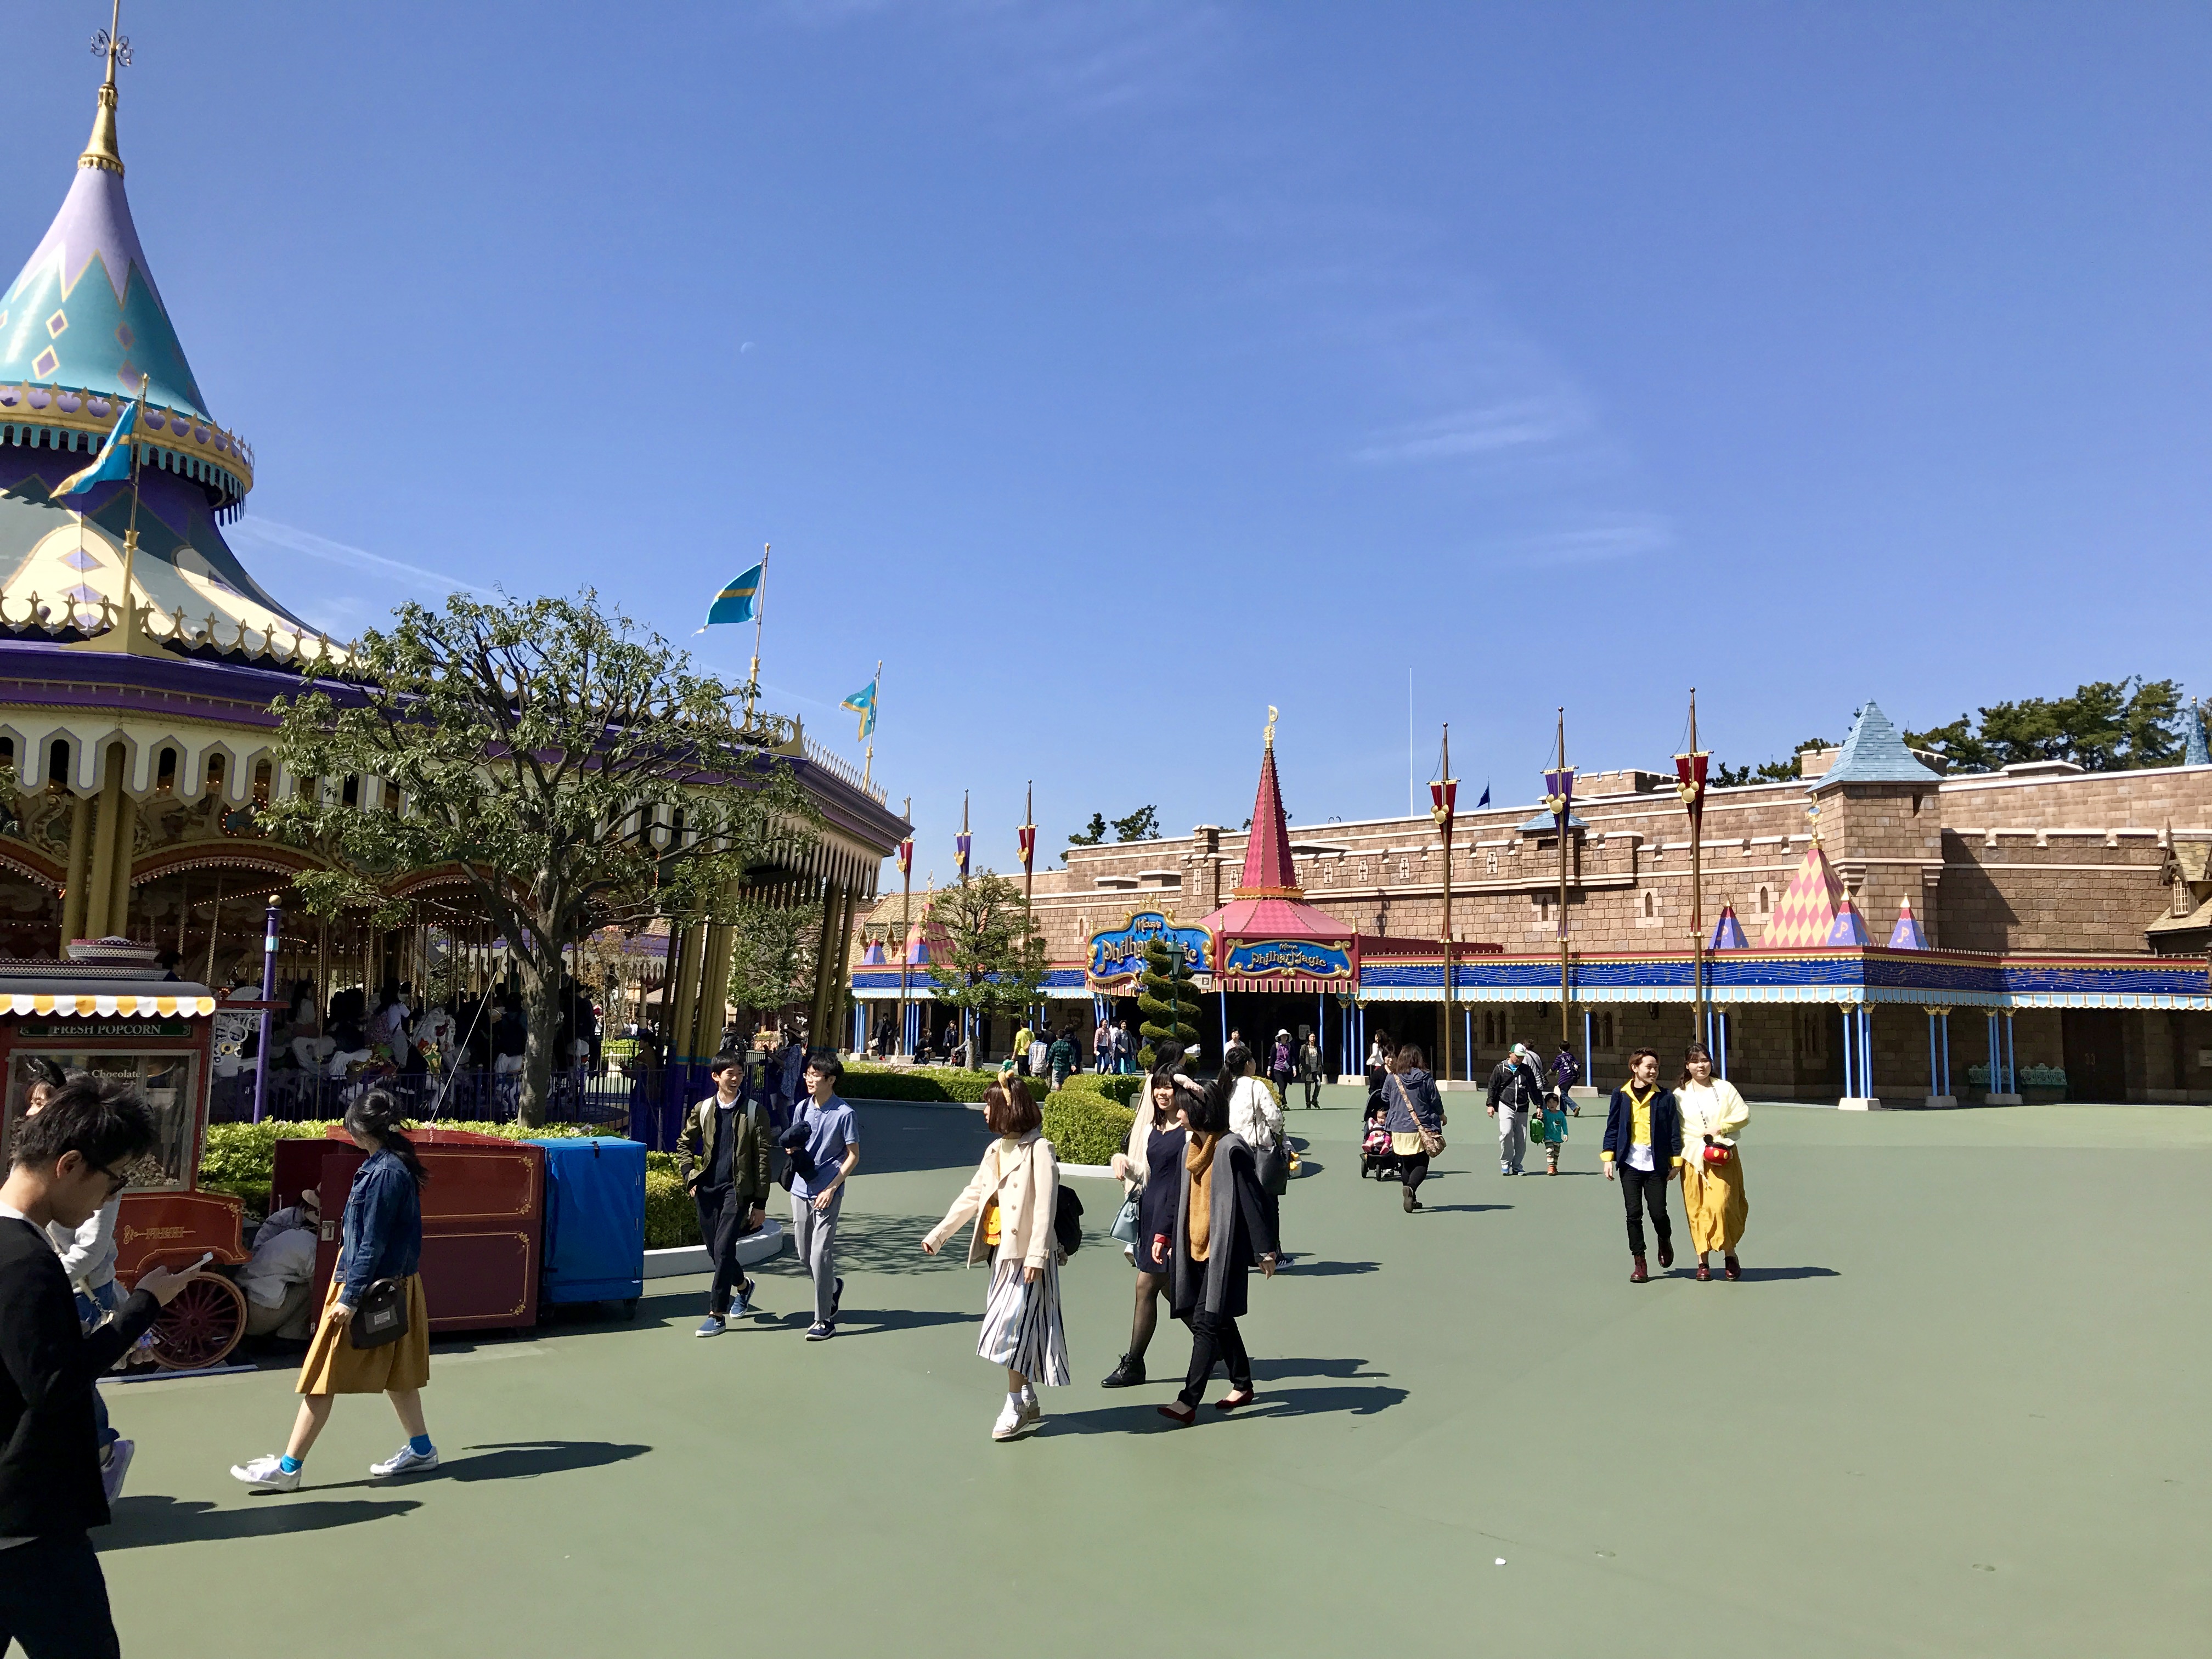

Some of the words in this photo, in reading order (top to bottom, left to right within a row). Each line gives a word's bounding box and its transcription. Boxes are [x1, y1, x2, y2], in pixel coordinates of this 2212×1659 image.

[1097, 933, 1197, 972] Philhaic
[1248, 950, 1326, 969] PhilharMagic
[53, 1025, 94, 1034] FRESH
[97, 1024, 161, 1034] POPCORN
[92, 1069, 141, 1078] Chocolate
[145, 1227, 184, 1239] FRESH
